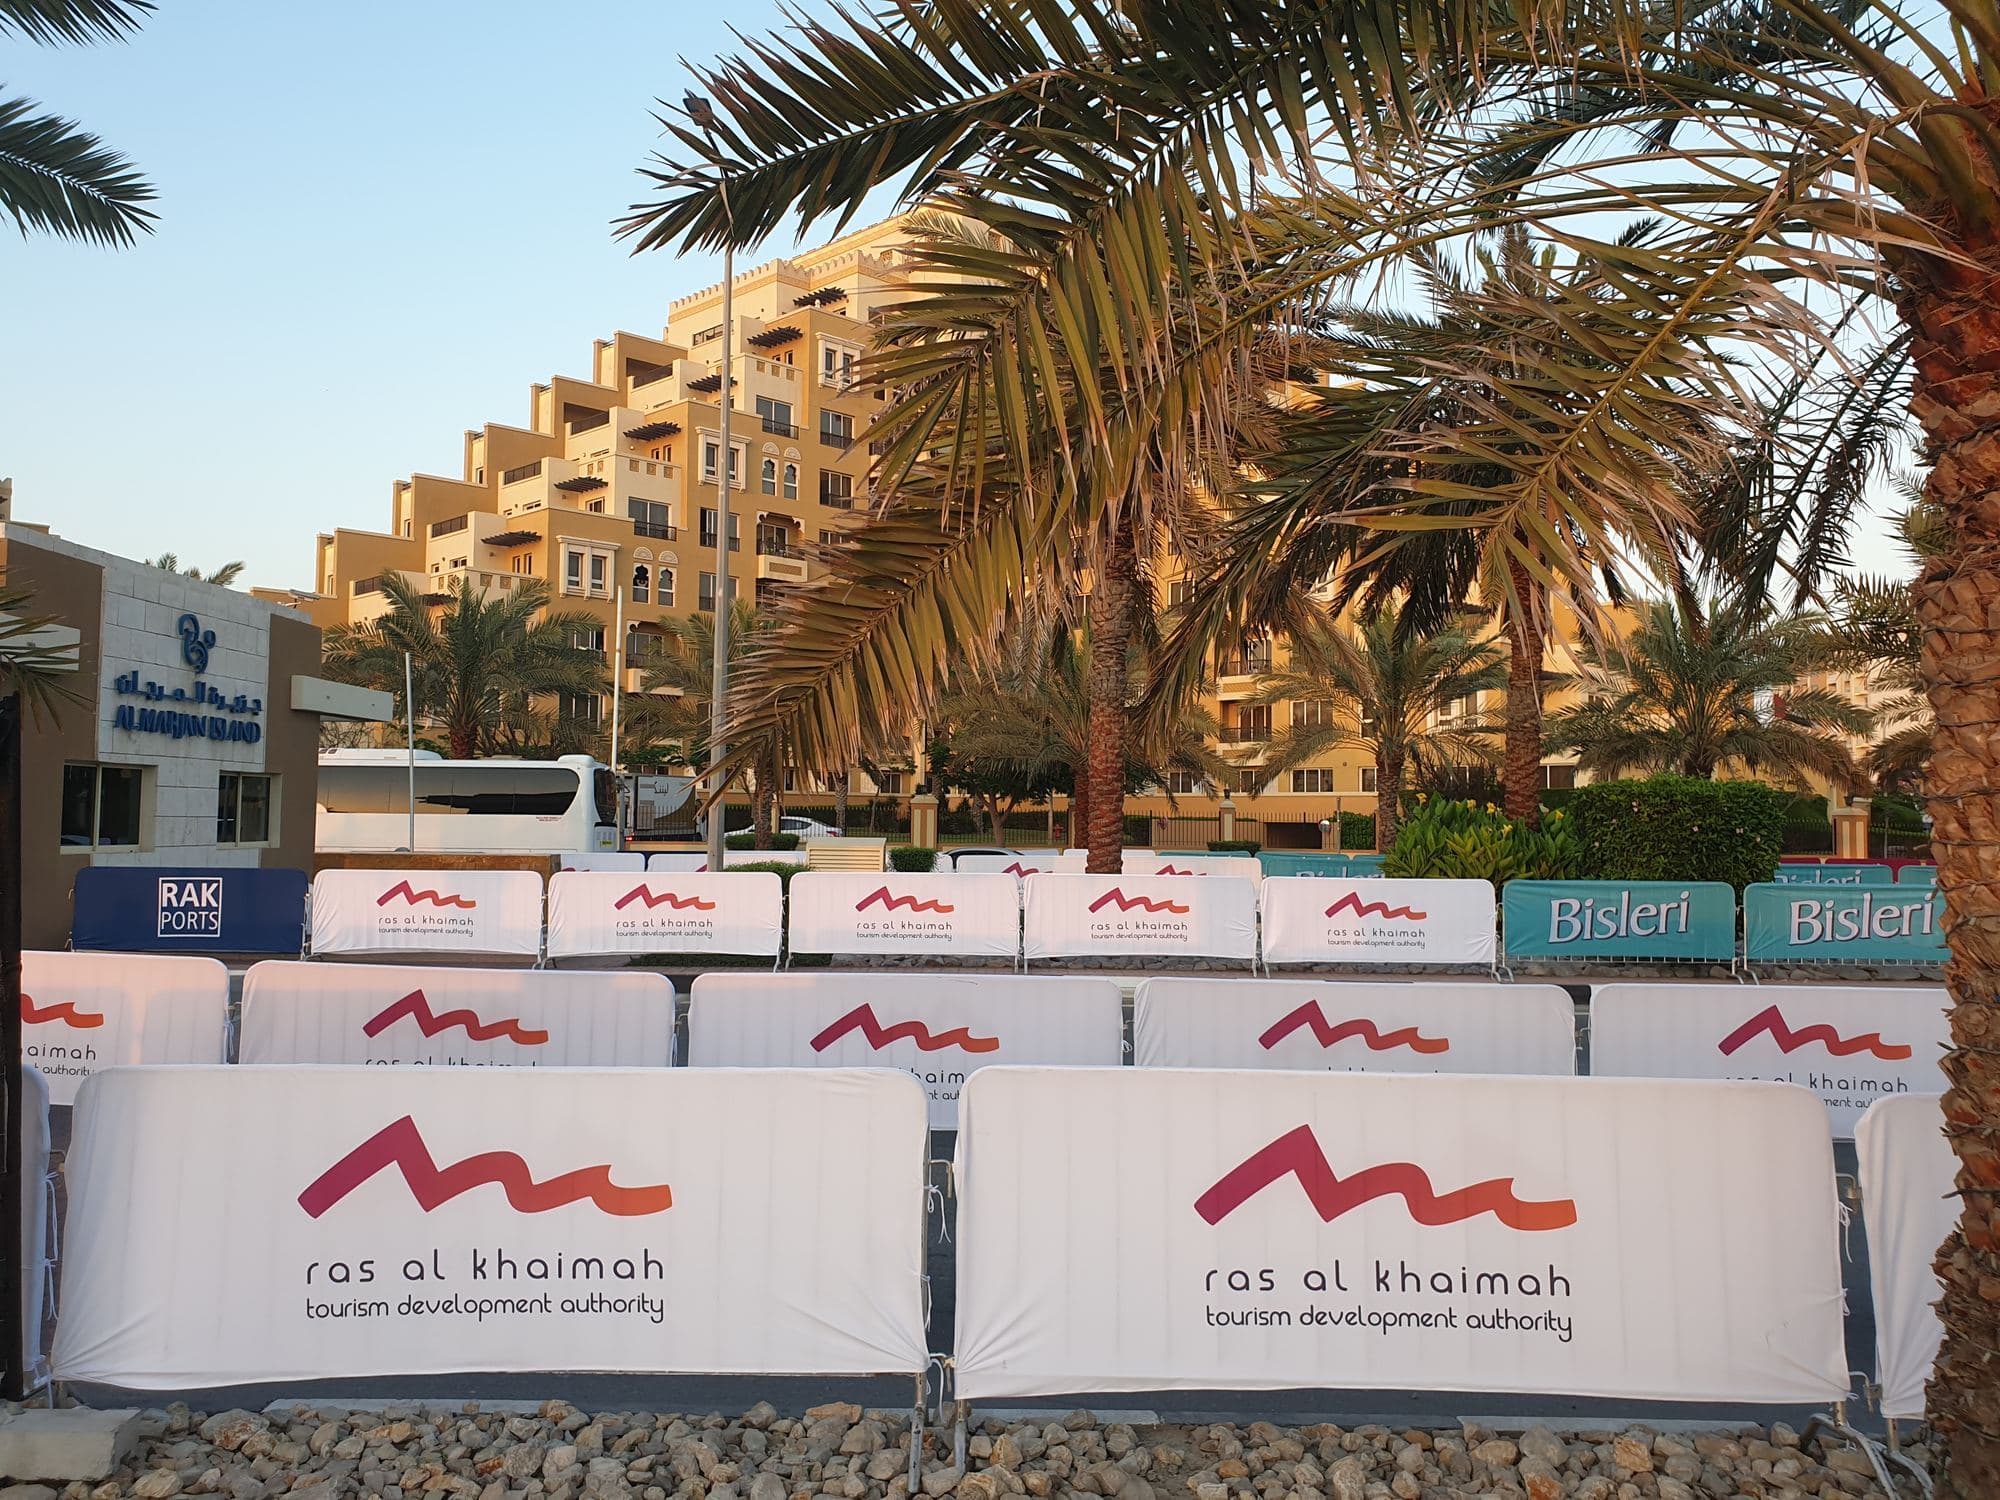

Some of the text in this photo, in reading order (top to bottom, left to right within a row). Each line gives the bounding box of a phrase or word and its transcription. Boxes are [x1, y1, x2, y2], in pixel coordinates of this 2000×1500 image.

[209, 716, 261, 744] ISLAND
[162, 882, 219, 907] RAK
[161, 911, 218, 930] PORTS
[404, 915, 416, 924] al
[422, 915, 474, 925] khaimah
[616, 918, 713, 928] ras al khaimah
[1548, 889, 1691, 944] Bisleri
[1789, 892, 1935, 945] Bisleri
[445, 928, 474, 937] authority
[857, 921, 952, 930] ras al khaimah
[1117, 921, 1129, 930] al
[1136, 921, 1188, 930] khaimah
[1353, 928, 1366, 936] al
[1372, 928, 1425, 937] khaimah
[641, 930, 683, 938] development
[684, 930, 713, 939] authority
[881, 932, 923, 940] development
[924, 932, 952, 942] authority
[1159, 933, 1188, 942] authority
[1352, 939, 1395, 947] development
[1396, 940, 1425, 949] authority
[27, 1044, 96, 1061] aimah
[42, 1064, 95, 1076] authorit
[1809, 1072, 1908, 1093] khaimah
[306, 1248, 664, 1285] ras al khaimah
[1205, 1259, 1570, 1297] ras al khaimah
[306, 1293, 664, 1324] tourism development authority
[1206, 1305, 1572, 1343] tourism development authority
